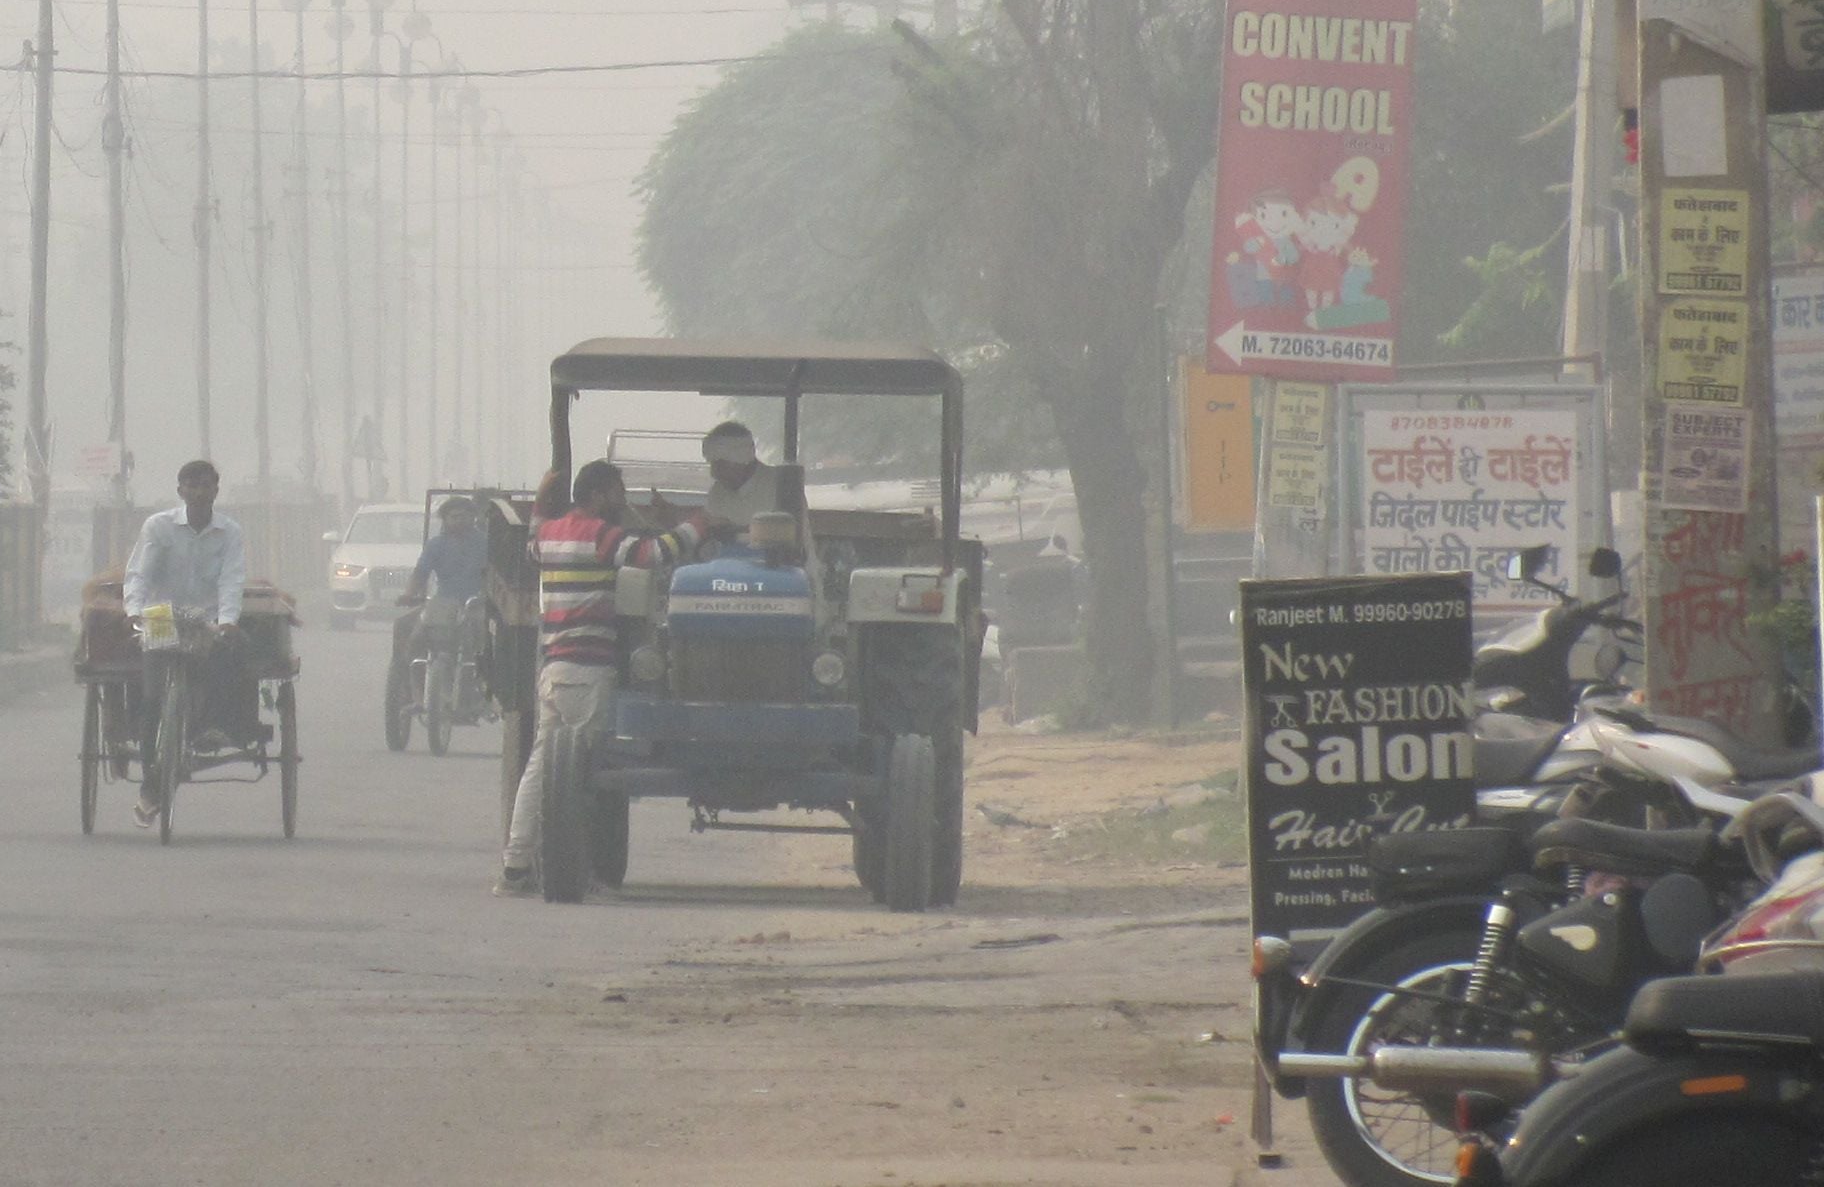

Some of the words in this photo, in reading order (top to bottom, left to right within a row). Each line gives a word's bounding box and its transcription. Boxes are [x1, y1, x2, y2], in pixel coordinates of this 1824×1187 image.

[1232, 10, 1412, 66] CONVENT
[1240, 81, 1394, 136] SCHOOL
[1241, 335, 1263, 354] M.
[1270, 337, 1389, 361] 72063-64674
[1673, 413, 1745, 427] SUBJECT
[1673, 425, 1742, 438] EXPERTS
[1367, 435, 1456, 489] टाईलें
[1487, 434, 1572, 489] टाईलें
[1440, 487, 1502, 532] पाईप
[1501, 489, 1567, 531] स्टोर
[1371, 533, 1434, 573] वालों
[1434, 532, 1472, 572] की
[1256, 606, 1324, 627] Ranjeet
[1329, 605, 1349, 623] M.
[1354, 600, 1466, 623] 99960-90278
[1259, 641, 1354, 682] New
[1304, 682, 1475, 724] FASHION
[1264, 726, 1475, 785] Salon
[1269, 810, 1372, 851] Hair
